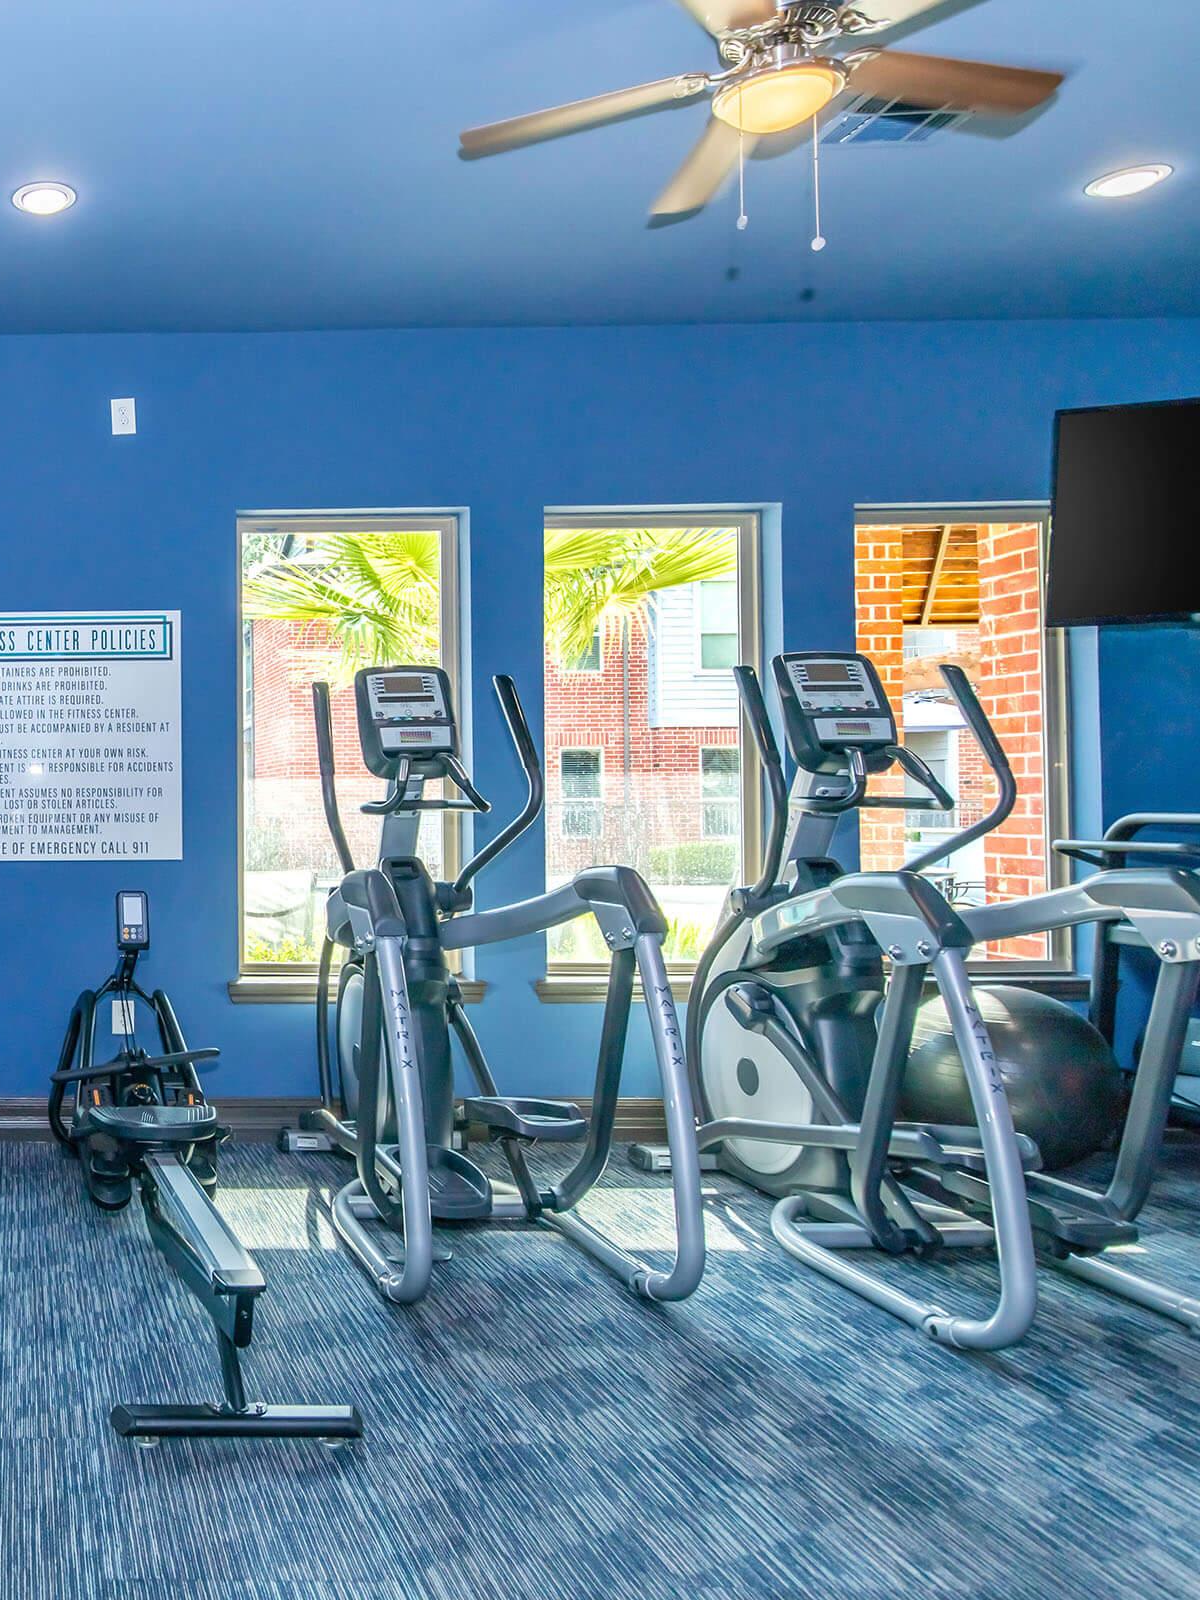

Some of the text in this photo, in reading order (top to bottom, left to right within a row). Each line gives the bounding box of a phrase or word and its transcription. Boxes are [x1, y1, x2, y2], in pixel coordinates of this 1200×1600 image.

[27, 630, 80, 650] CENTER
[91, 629, 156, 650] POLICIES
[39, 668, 55, 677] ARE
[58, 667, 111, 677] PROHIBITED.
[1, 682, 32, 691] DRINKS
[36, 682, 51, 690] ARE
[55, 681, 107, 690] PROHIBITED.
[17, 696, 45, 705] ATTIRE
[48, 696, 56, 704] IS
[60, 695, 104, 704] REQUIRED.
[37, 710, 45, 719] IN
[49, 710, 64, 718] THE
[68, 709, 101, 718] FITNESS
[105, 709, 138, 718] CENTER.
[18, 724, 27, 733] BE
[30, 723, 90, 733] ACCOMPANIED
[94, 723, 105, 732] BY
[108, 723, 113, 732] A
[117, 723, 157, 732] RESIDENT
[160, 722, 169, 731] AT
[31, 749, 62, 758] CENTER
[66, 749, 76, 757] AT
[79, 749, 101, 757] YOUR
[104, 748, 123, 757] OWN
[127, 748, 148, 757] RISK.
[18, 764, 26, 772] IS
[48, 763, 105, 772] RESPONSIBLE
[109, 763, 124, 771] FOR
[127, 762, 173, 771] ACCIDENTS
[18, 789, 57, 797] ASSUMES
[61, 788, 72, 797] NO
[76, 788, 143, 797] RESPONSIBILITY
[147, 788, 163, 797] FOR
[4, 800, 24, 808] LOST
[27, 800, 38, 808] OR
[42, 799, 72, 808] STOLEN
[76, 799, 117, 808] ARTICLES.
[28, 814, 77, 823] EQUIPMENT
[80, 814, 91, 822] OR
[94, 813, 110, 822] ANY
[114, 813, 145, 822] MISUSE
[149, 813, 159, 822] OF
[27, 825, 37, 834] TO
[41, 824, 102, 834] MANAGEMENT.
[12, 842, 25, 854] OF
[30, 842, 96, 854] EMERGENCY
[101, 841, 128, 853] CALL
[133, 841, 149, 853] 911
[390, 989, 413, 1068] MATRIX
[654, 986, 683, 1066] MATRIX
[965, 1005, 1003, 1093] MATRIX
